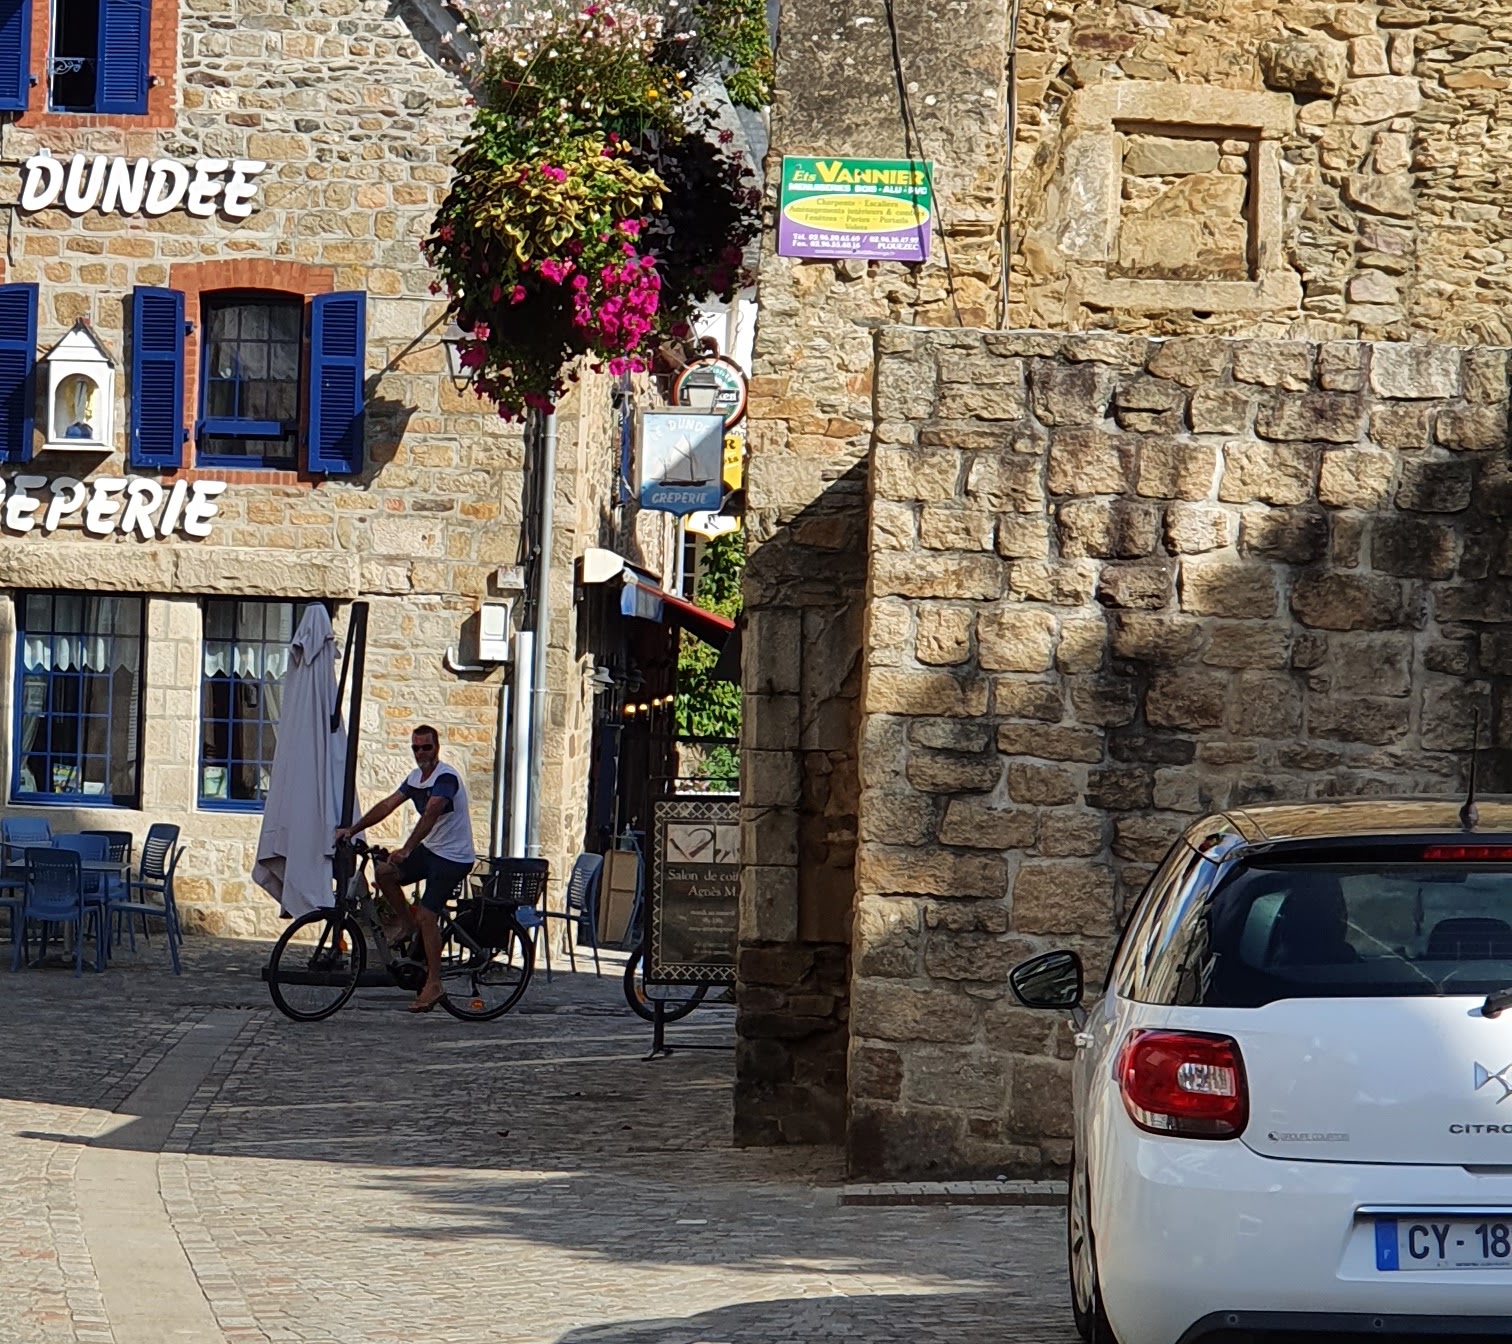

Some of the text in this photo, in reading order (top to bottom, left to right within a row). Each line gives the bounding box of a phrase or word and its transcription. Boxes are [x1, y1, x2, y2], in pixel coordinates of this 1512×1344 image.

[792, 160, 925, 185] Ets VANNIER
[21, 153, 267, 218] DUNDEE
[854, 184, 877, 193] BOIS
[882, 185, 902, 194] ALU
[908, 186, 928, 195] PVC
[651, 492, 708, 505] CREPERIE
[668, 868, 698, 881] Salon
[704, 869, 718, 881] de
[688, 885, 722, 898] Agnès
